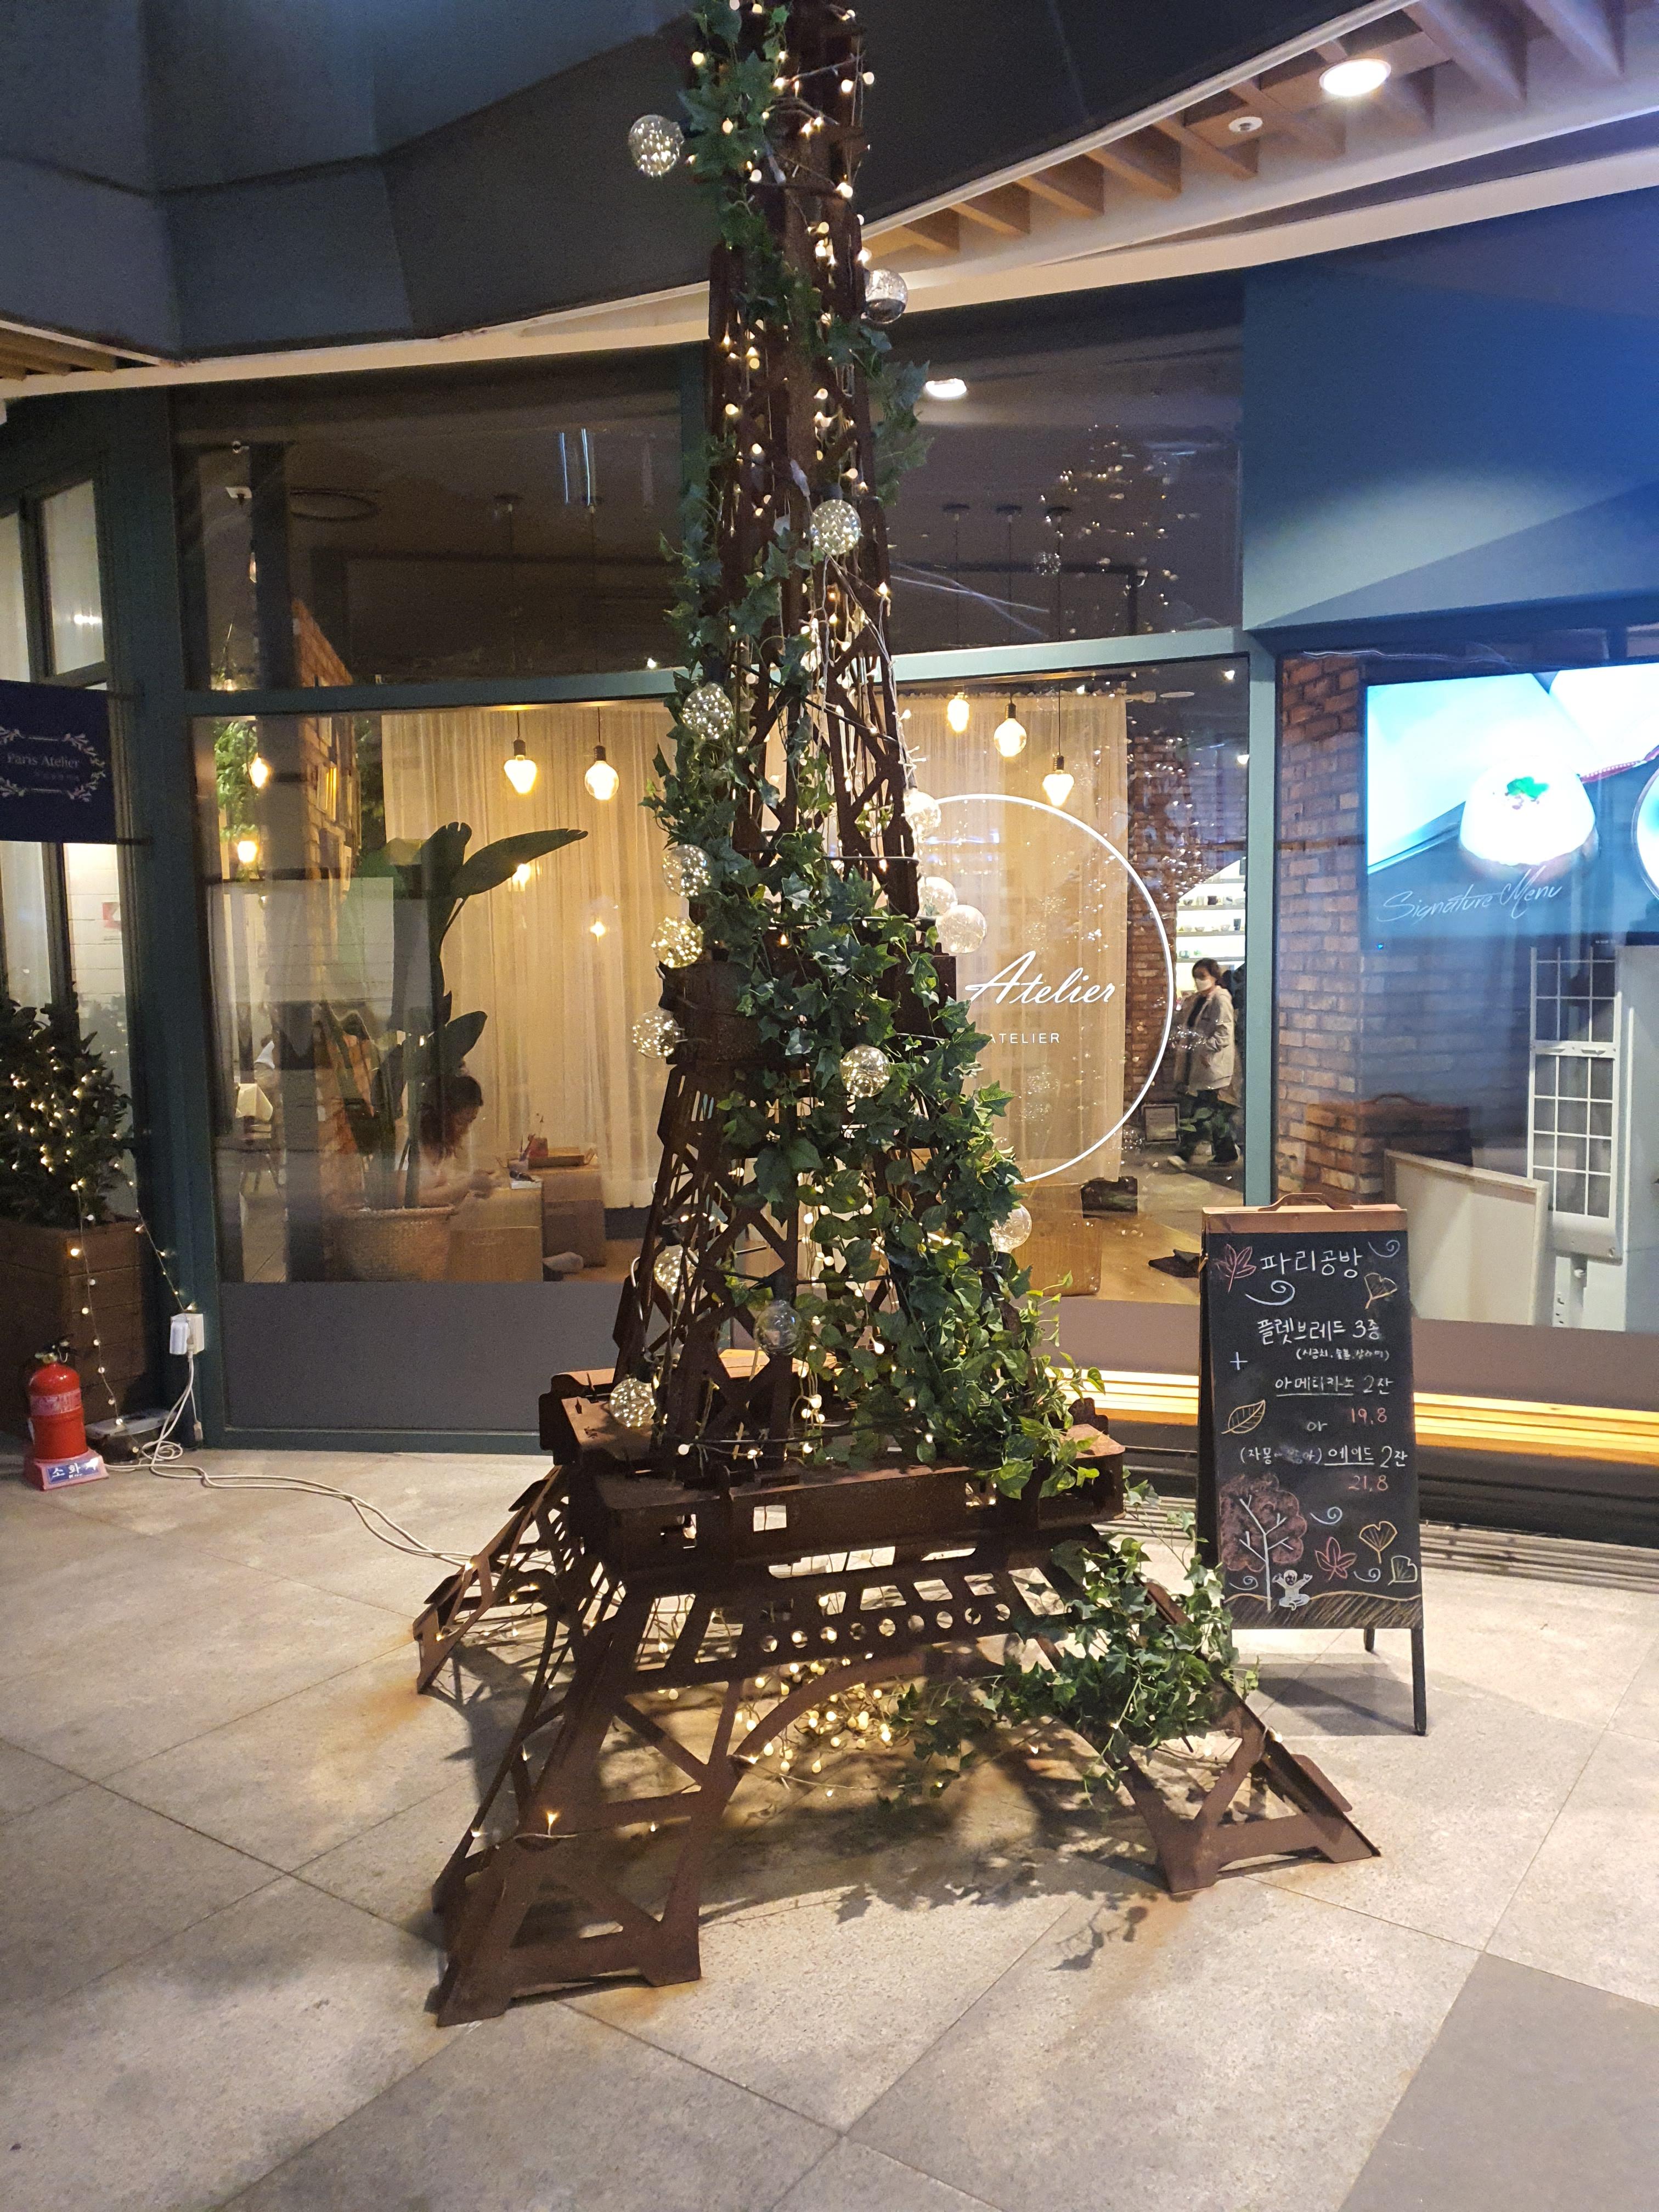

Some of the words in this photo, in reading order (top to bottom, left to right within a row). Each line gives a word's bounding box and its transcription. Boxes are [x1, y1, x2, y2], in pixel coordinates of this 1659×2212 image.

[7, 752, 38, 765] Paris
[41, 755, 80, 769] Atelier
[1376, 884, 1500, 926] Signature
[1500, 865, 1562, 919] Menu
[964, 950, 1115, 1005] Atelier
[989, 1033, 1060, 1043] ATELIER
[1260, 1248, 1362, 1278] 파리공방
[1257, 1318, 1346, 1345] 플렛브레드
[1352, 1319, 1381, 1340] 3종
[1363, 1375, 1394, 1395] 2잔
[1351, 1407, 1387, 1423] 19.8
[1328, 1445, 1375, 1462] 에이드
[1380, 1446, 1408, 1468] 2잔
[52, 1458, 97, 1478] 소화
[1348, 1475, 1389, 1491] 21.8
